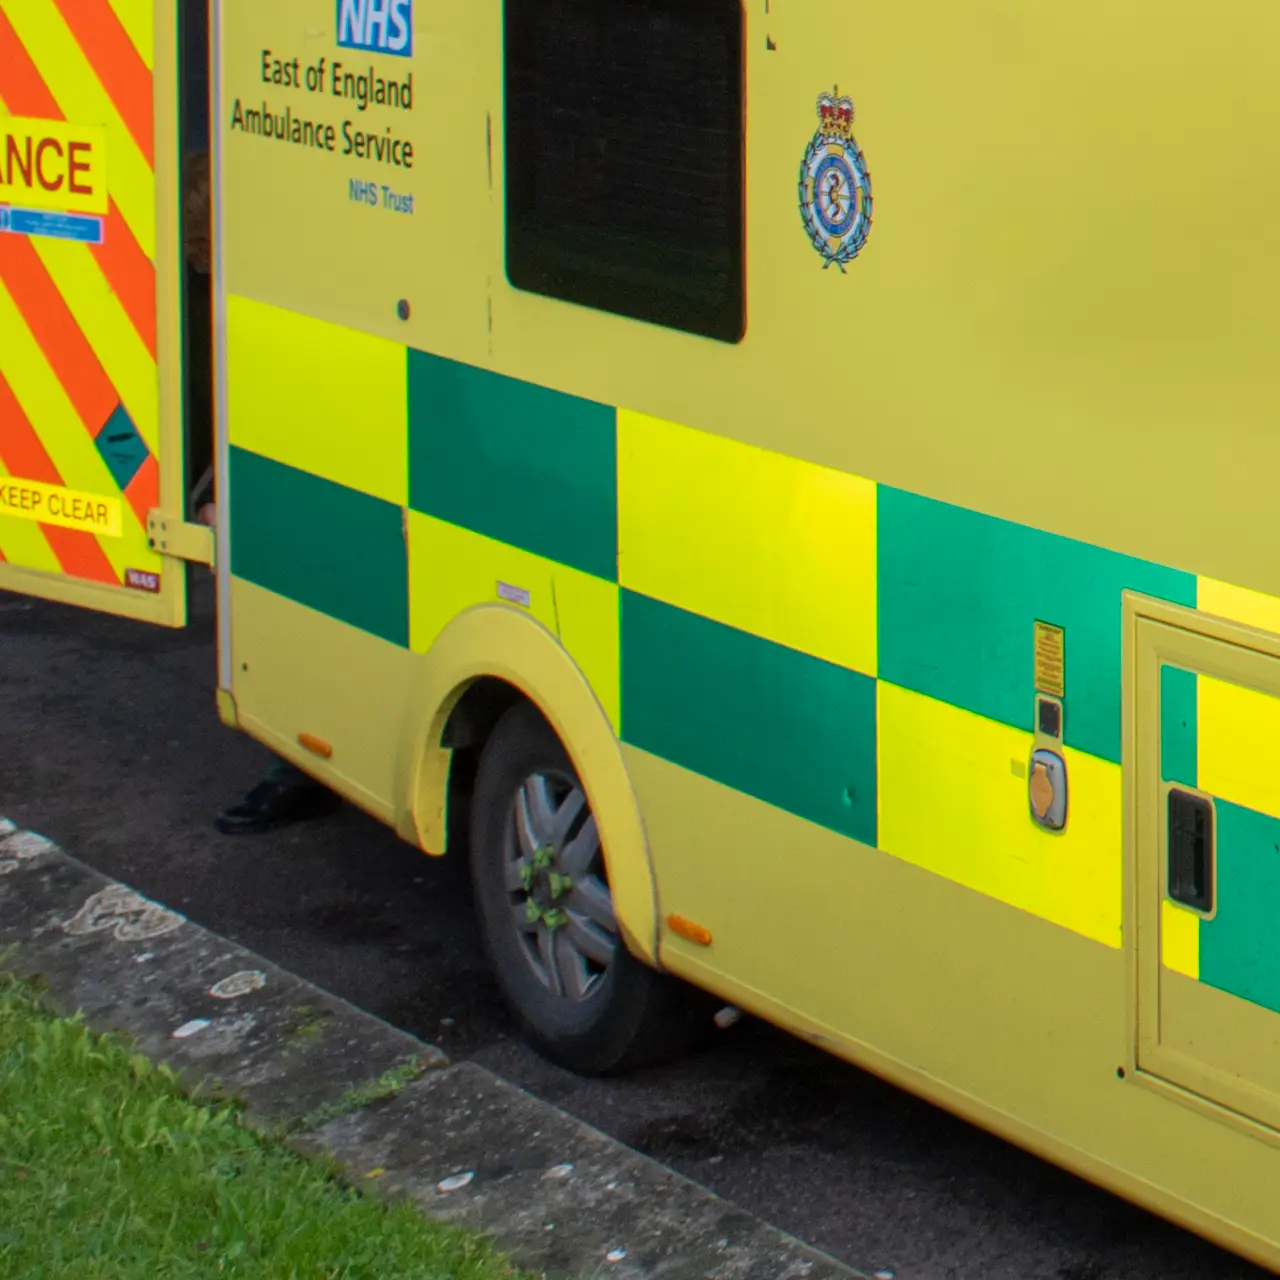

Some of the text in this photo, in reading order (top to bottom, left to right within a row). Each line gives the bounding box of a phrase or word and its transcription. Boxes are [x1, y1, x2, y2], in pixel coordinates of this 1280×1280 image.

[261, 49, 413, 111] East of England
[231, 98, 414, 169] Ambulance Service
[0, 133, 93, 196] NCE
[348, 178, 414, 215] NHS Trust
[48, 493, 108, 526] CLEAR
[127, 570, 157, 590] WAS
